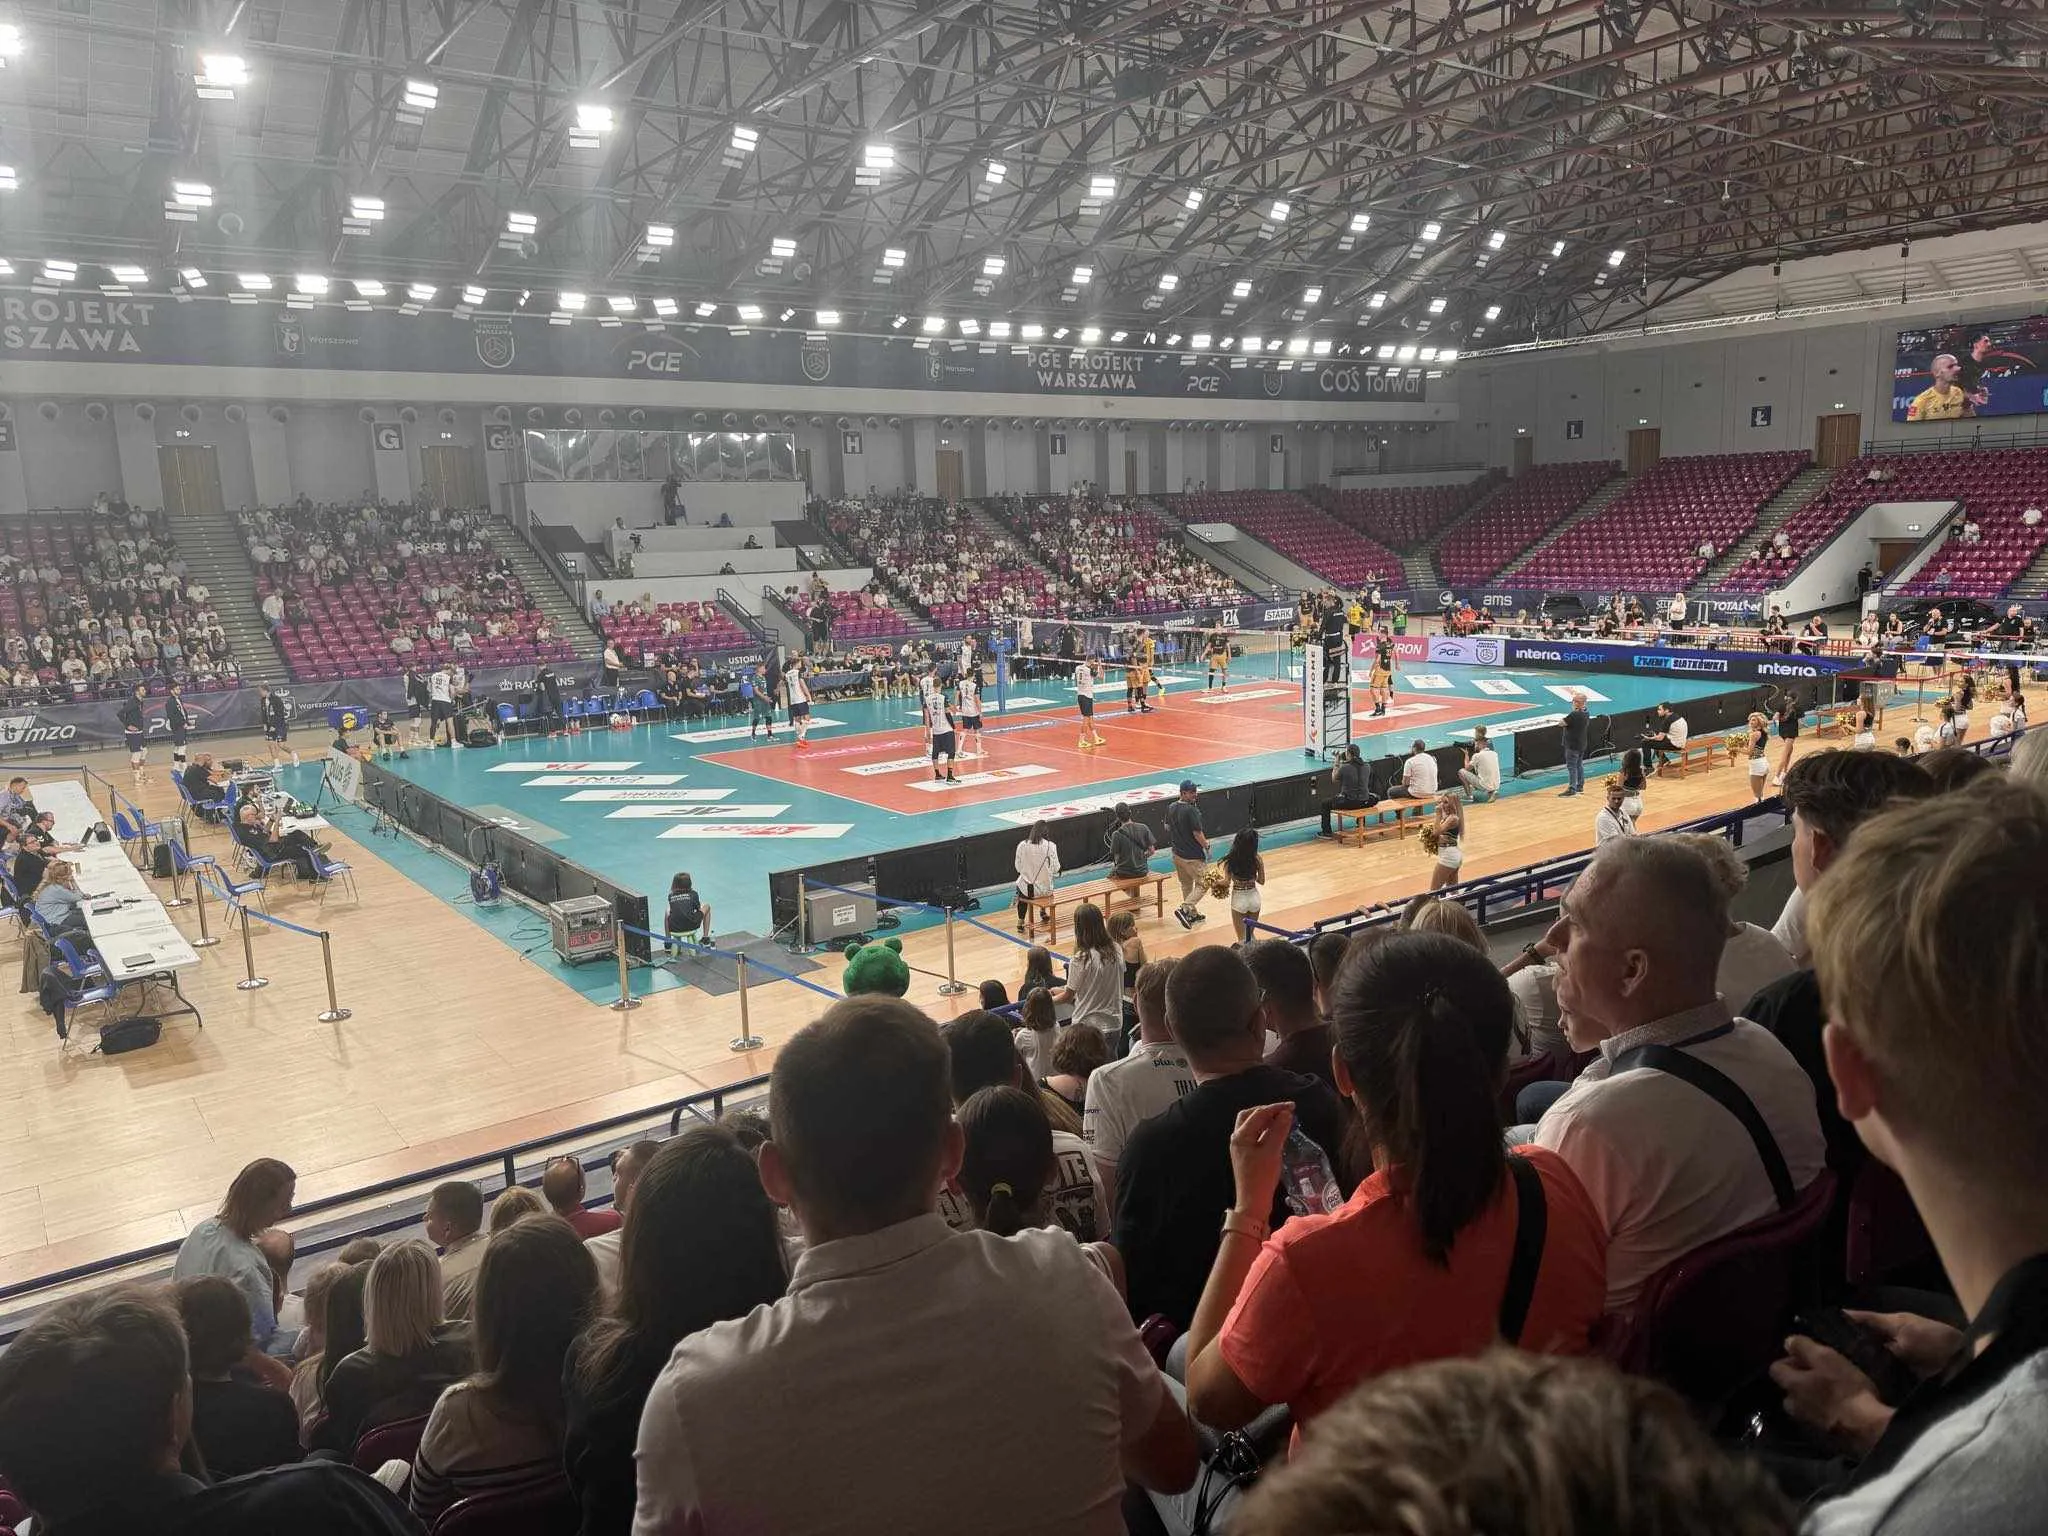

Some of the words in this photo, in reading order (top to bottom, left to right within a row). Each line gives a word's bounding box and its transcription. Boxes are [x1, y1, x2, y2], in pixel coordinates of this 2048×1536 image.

[4, 298, 155, 325] ROJEKT
[4, 325, 142, 352] SZAWA
[627, 350, 683, 372] PGE
[1027, 352, 1062, 369] PGE
[1068, 353, 1144, 371] PROJEKT
[1036, 370, 1137, 390] WARSZAWA
[1186, 376, 1220, 392] PGE
[379, 429, 399, 449] G
[846, 436, 860, 453] H
[1482, 593, 1513, 607] ams
[1438, 648, 1462, 657] PGE
[1515, 648, 1561, 660] interia
[1562, 651, 1605, 663] SPORT
[1757, 662, 1817, 677] interia
